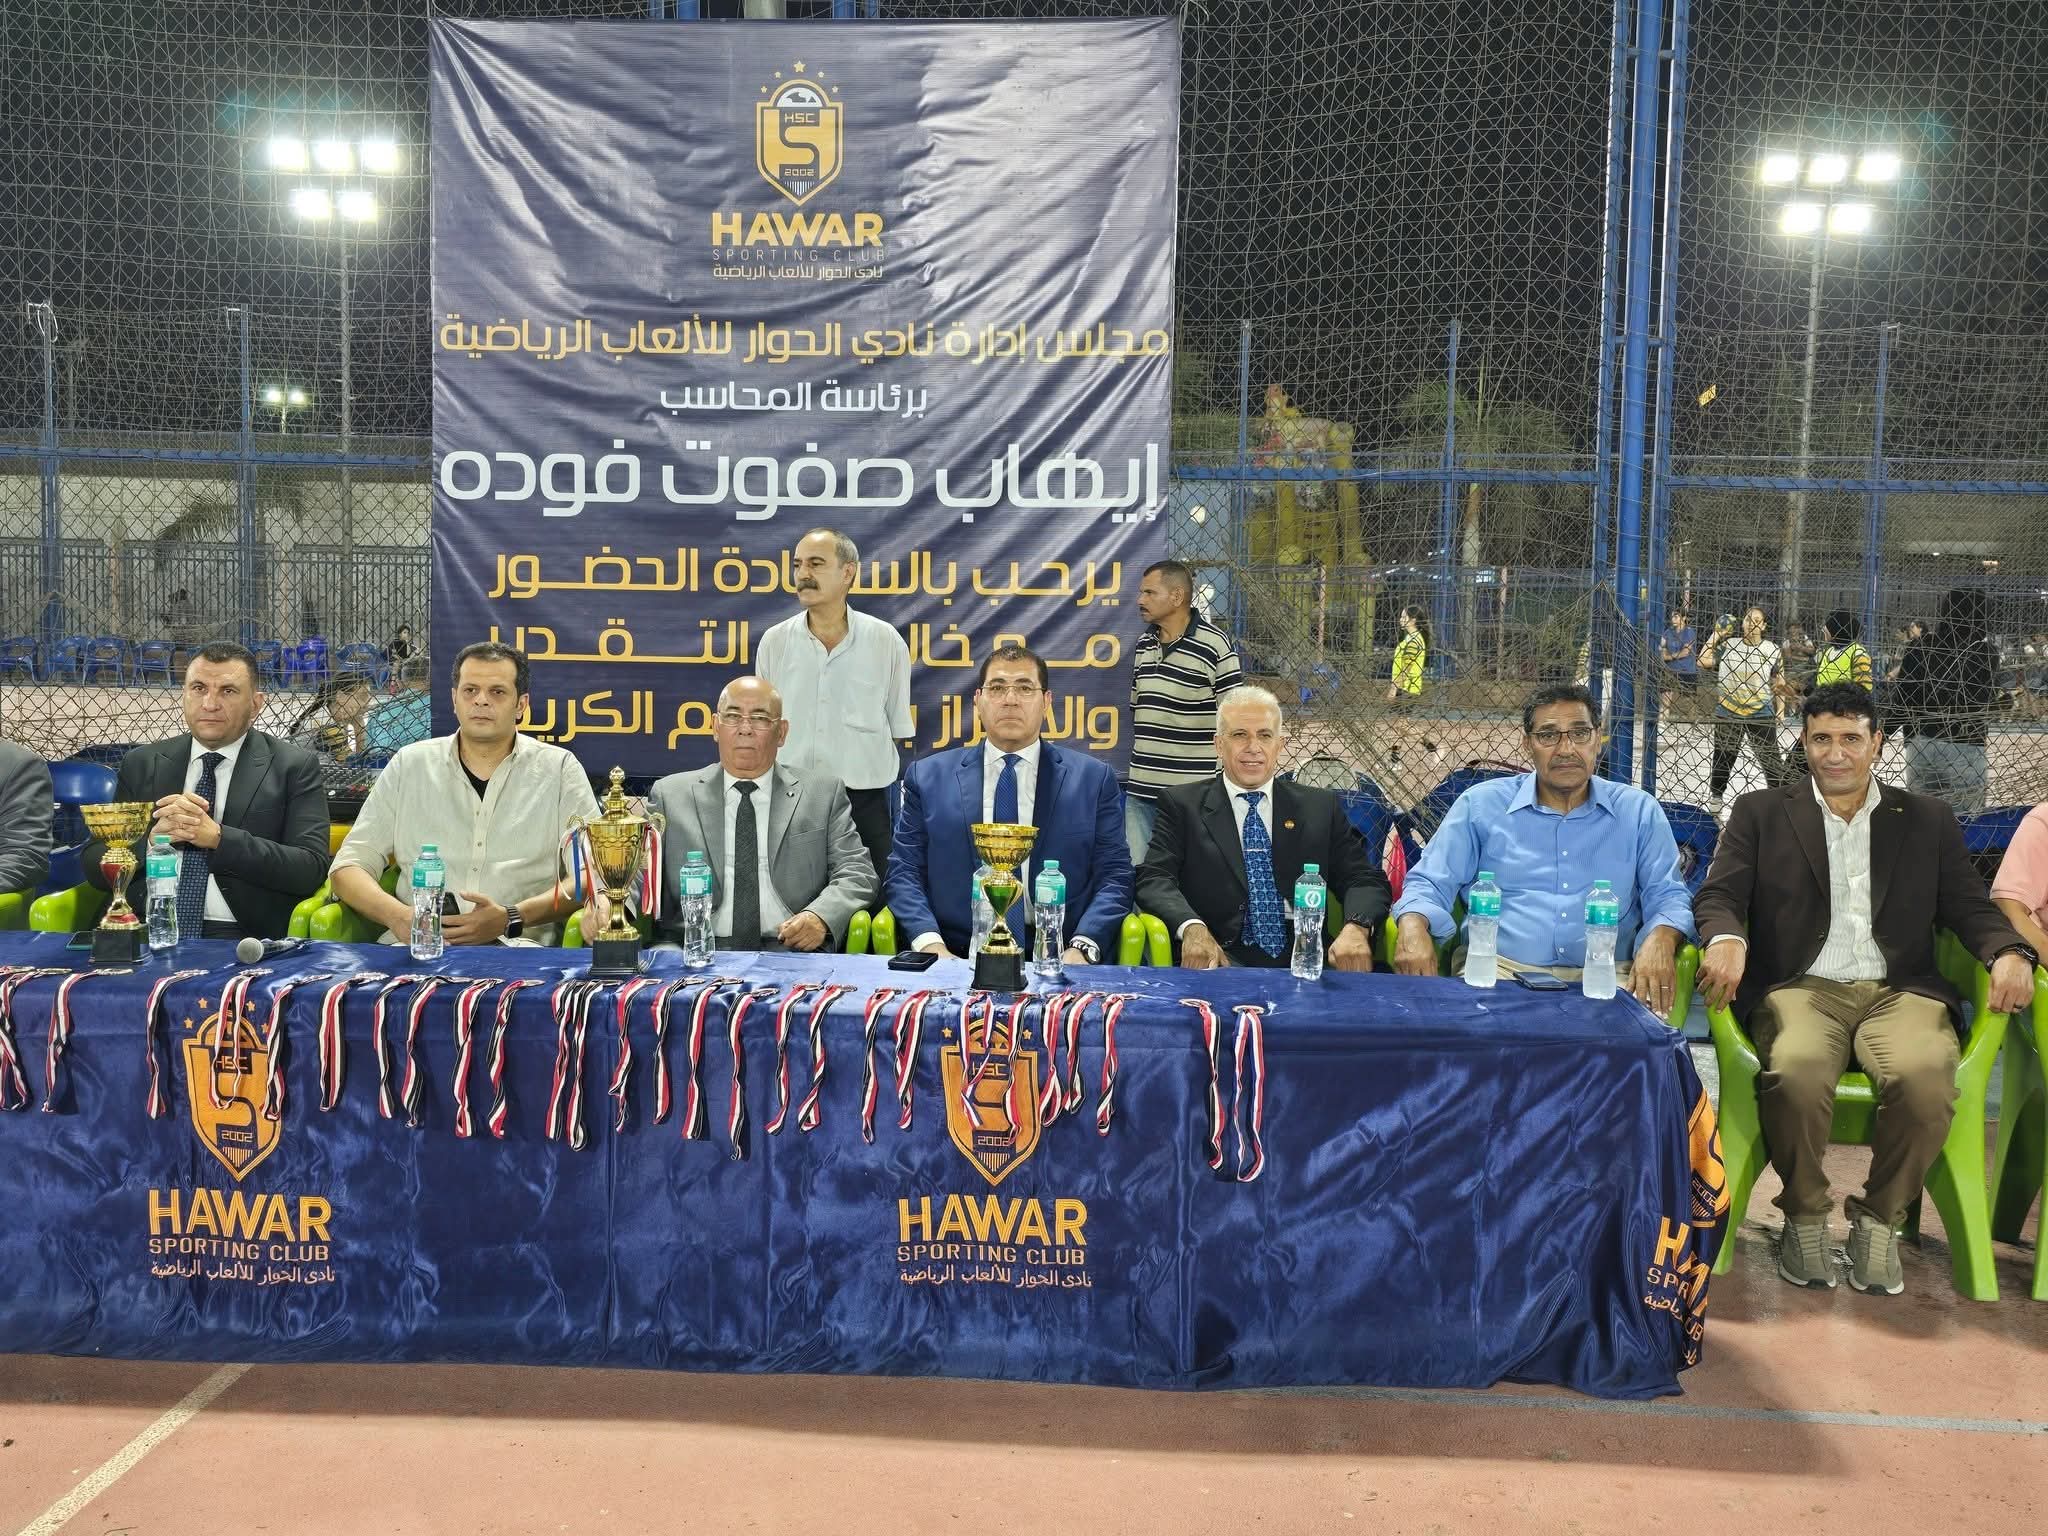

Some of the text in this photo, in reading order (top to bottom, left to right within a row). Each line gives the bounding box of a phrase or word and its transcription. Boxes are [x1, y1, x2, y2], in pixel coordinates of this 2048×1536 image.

[784, 113, 816, 123] HSC
[784, 168, 815, 177] 2002
[712, 212, 884, 247] HAWAR
[712, 249, 885, 263] SPORTING CLUB
[713, 263, 766, 281] الرياضية
[817, 265, 851, 281] الحوار
[440, 311, 1170, 365] مجلس إدارة نادي الحوار للألعاب الرياضية
[660, 379, 928, 418] برئاسة المحاسب
[440, 439, 1159, 523] إيهاب صفوت فوده
[488, 546, 699, 599] الحضور
[972, 559, 1122, 607] يرحب
[909, 623, 975, 667] خال
[221, 1130, 253, 1143] 2002
[977, 1135, 1010, 1147] 2002
[149, 1187, 332, 1242] HAWAR
[898, 1194, 1087, 1246] HAWAR
[149, 1237, 329, 1262] SPORTING CLUB
[897, 1243, 1085, 1265] SPORTING CLUB
[151, 1258, 201, 1279] الرياضية
[257, 1266, 301, 1286] الحوار
[900, 1263, 954, 1285] الرياضية
[1016, 1268, 1059, 1289] الحوار
